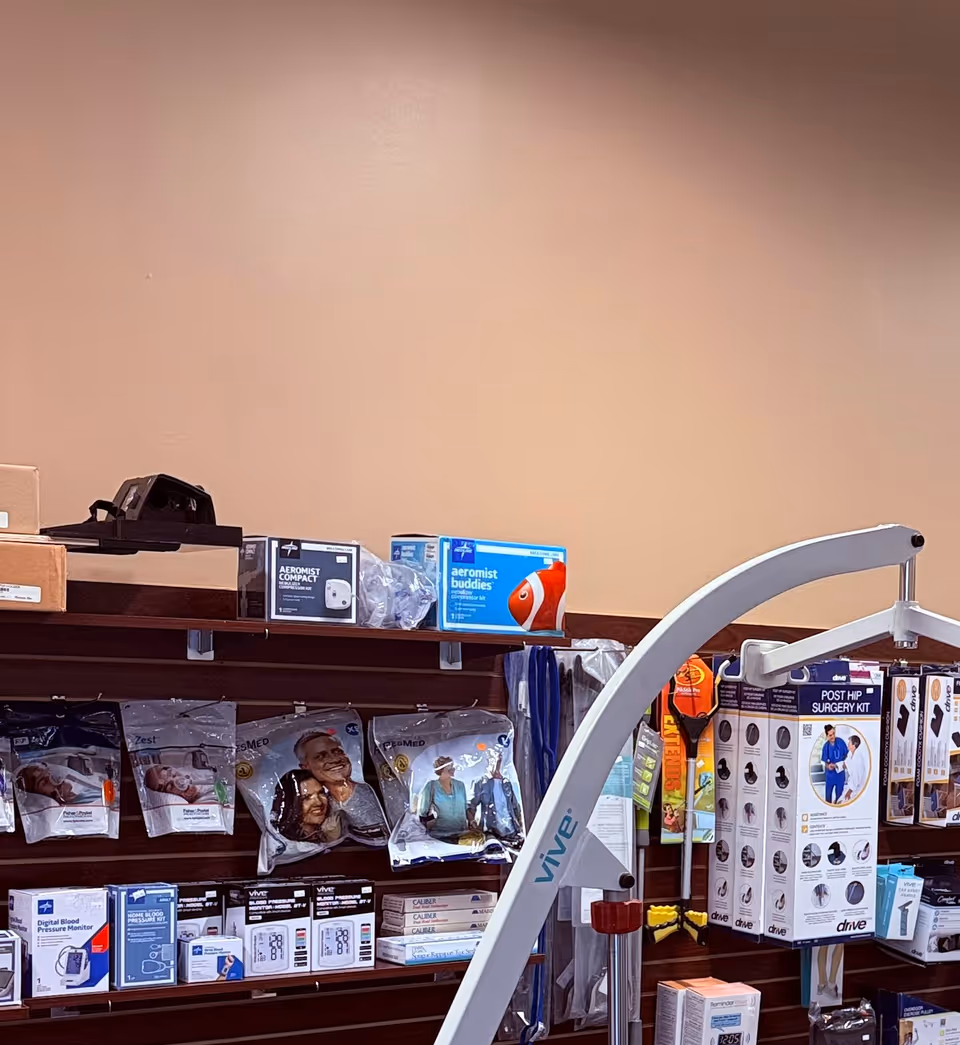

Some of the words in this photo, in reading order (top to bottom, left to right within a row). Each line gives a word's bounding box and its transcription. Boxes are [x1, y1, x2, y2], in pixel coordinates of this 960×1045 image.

[279, 565, 320, 576] AEROMIST
[451, 567, 498, 580] aeromist
[279, 574, 318, 583] COMPACT
[451, 577, 493, 591] buddies
[821, 690, 845, 701] POST
[847, 691, 862, 701] HIP
[909, 685, 917, 712] drive
[812, 702, 855, 713] SURGERY
[856, 703, 870, 713] KIT
[346, 724, 360, 735] XS
[134, 735, 157, 745] Zest
[534, 814, 579, 883] vive
[249, 889, 269, 898] vive
[316, 886, 335, 894] vive
[412, 898, 437, 906] CALIBER
[127, 912, 144, 920] HOME
[127, 916, 155, 924] PRESSURE
[413, 912, 437, 921] CALIBER
[711, 911, 729, 923] drive
[37, 919, 60, 928] Digital
[60, 917, 80, 925] Blood
[735, 918, 753, 930] drive
[836, 919, 867, 932] drive
[37, 926, 66, 934] Pressure
[67, 923, 94, 931] Monitor
[411, 926, 437, 935] CALIBER
[768, 924, 787, 936] drive
